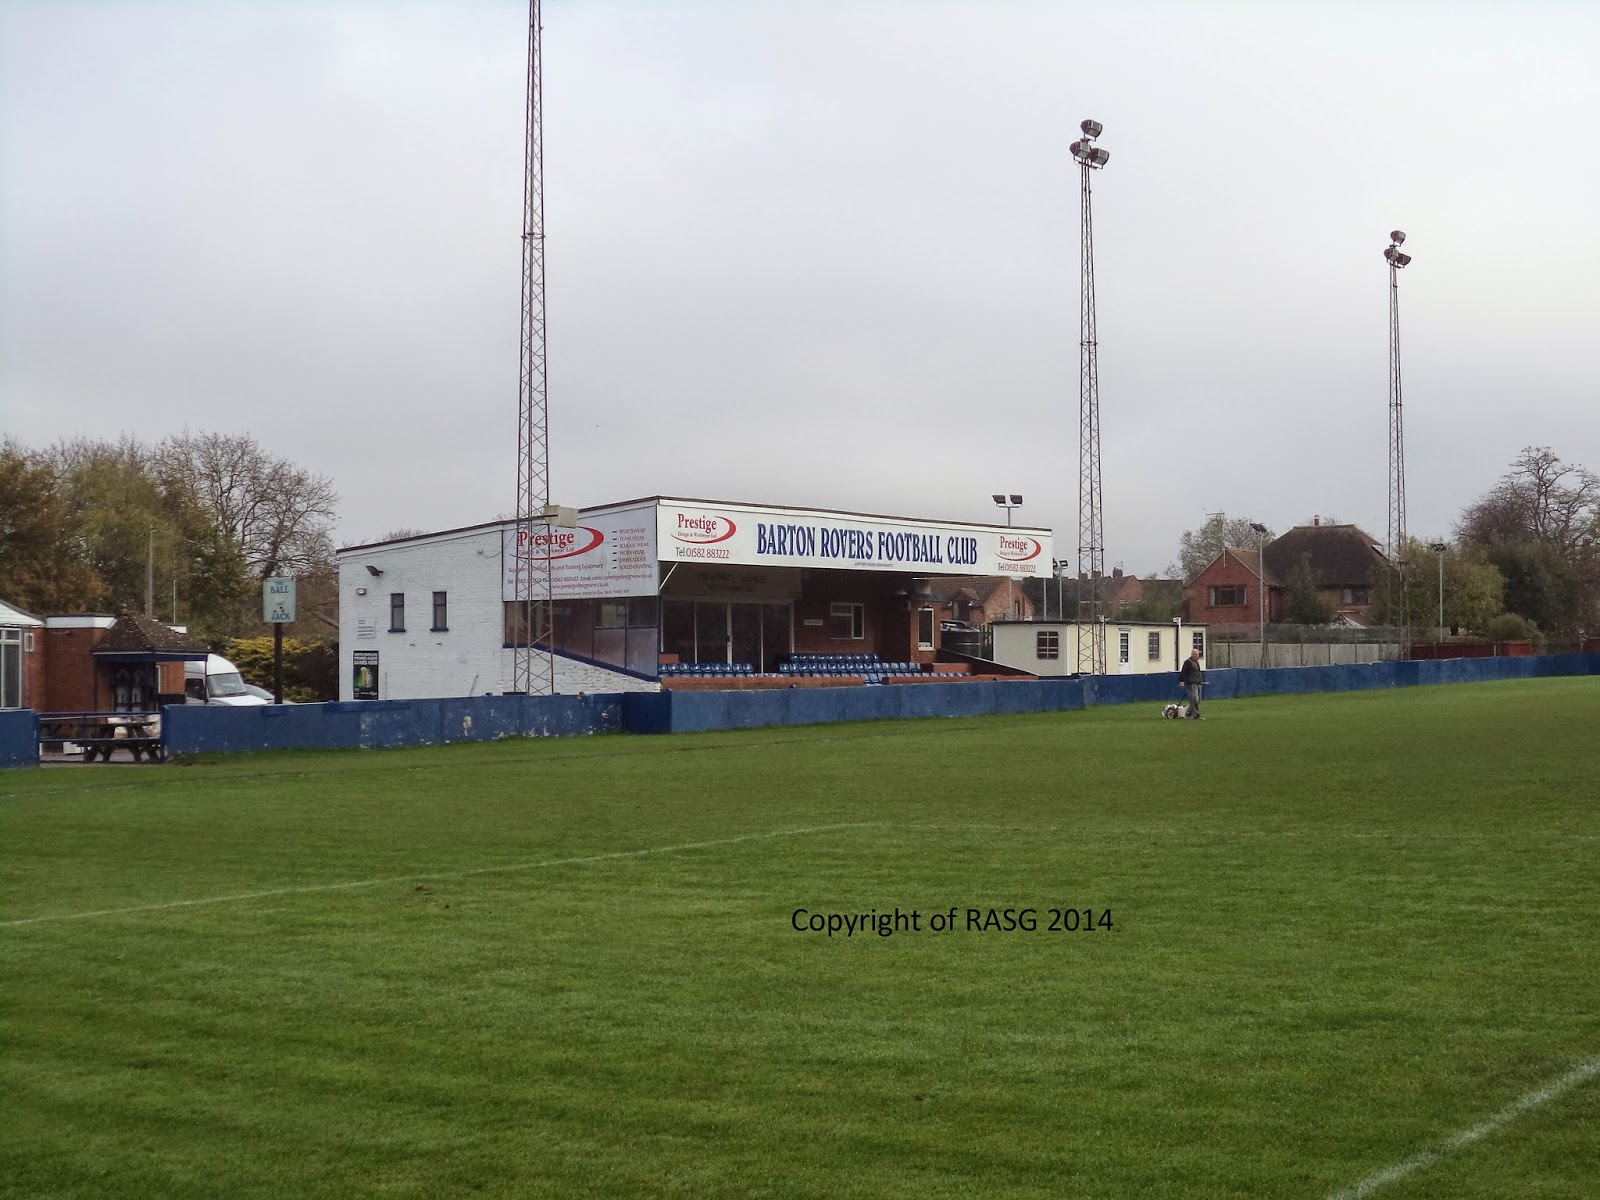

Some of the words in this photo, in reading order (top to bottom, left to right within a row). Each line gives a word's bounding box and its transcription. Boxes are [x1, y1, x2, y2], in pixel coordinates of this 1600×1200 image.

[677, 513, 717, 534] Prestige
[518, 529, 574, 548] Prestige
[756, 523, 816, 556] BARTON
[820, 527, 874, 560] ROVERS
[877, 531, 943, 563] FOOTBALL
[947, 536, 978, 565] CLUB
[999, 535, 1028, 553] Prestige
[706, 548, 730, 559] 883222
[270, 586, 289, 594] BALL
[271, 612, 290, 620] JACK
